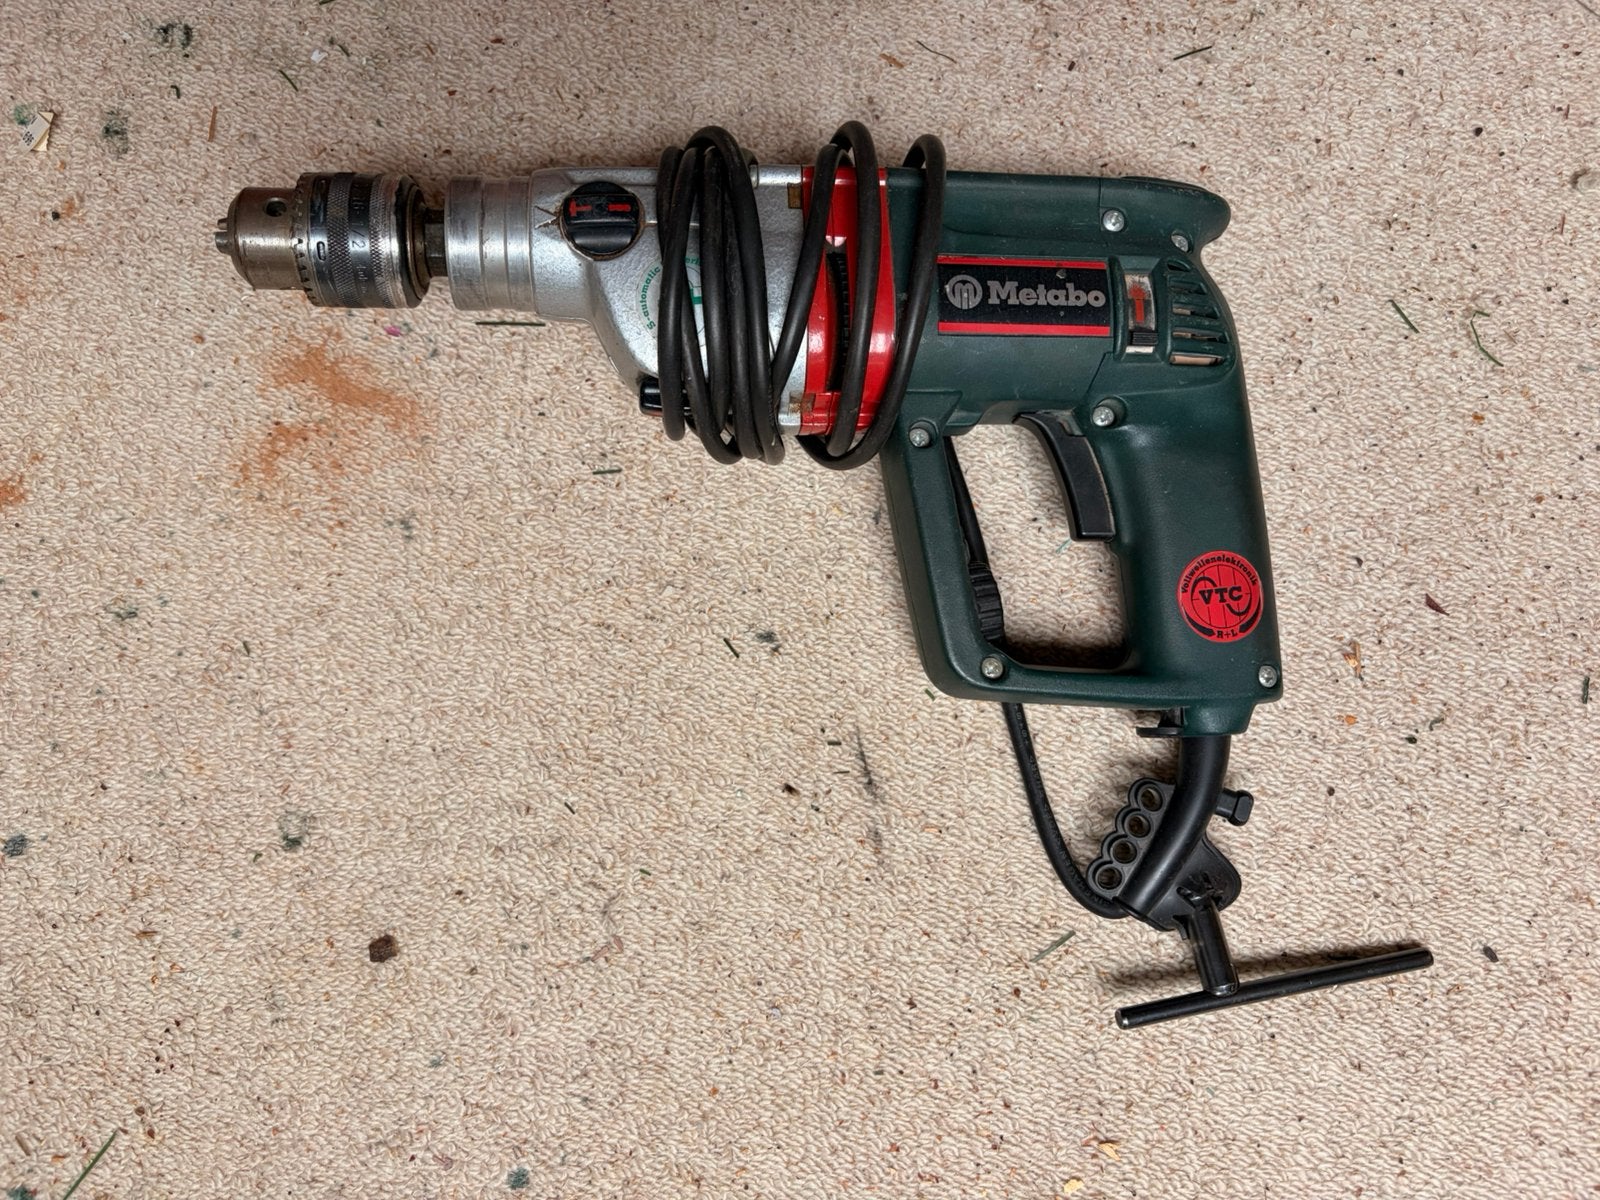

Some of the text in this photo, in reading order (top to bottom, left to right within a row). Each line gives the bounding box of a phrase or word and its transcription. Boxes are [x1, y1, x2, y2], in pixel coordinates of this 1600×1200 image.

[640, 266, 661, 330] S-automatic
[987, 280, 1106, 308] Metabo
[1181, 555, 1257, 593] Vollwellenelektronik
[1198, 586, 1243, 605] VTC
